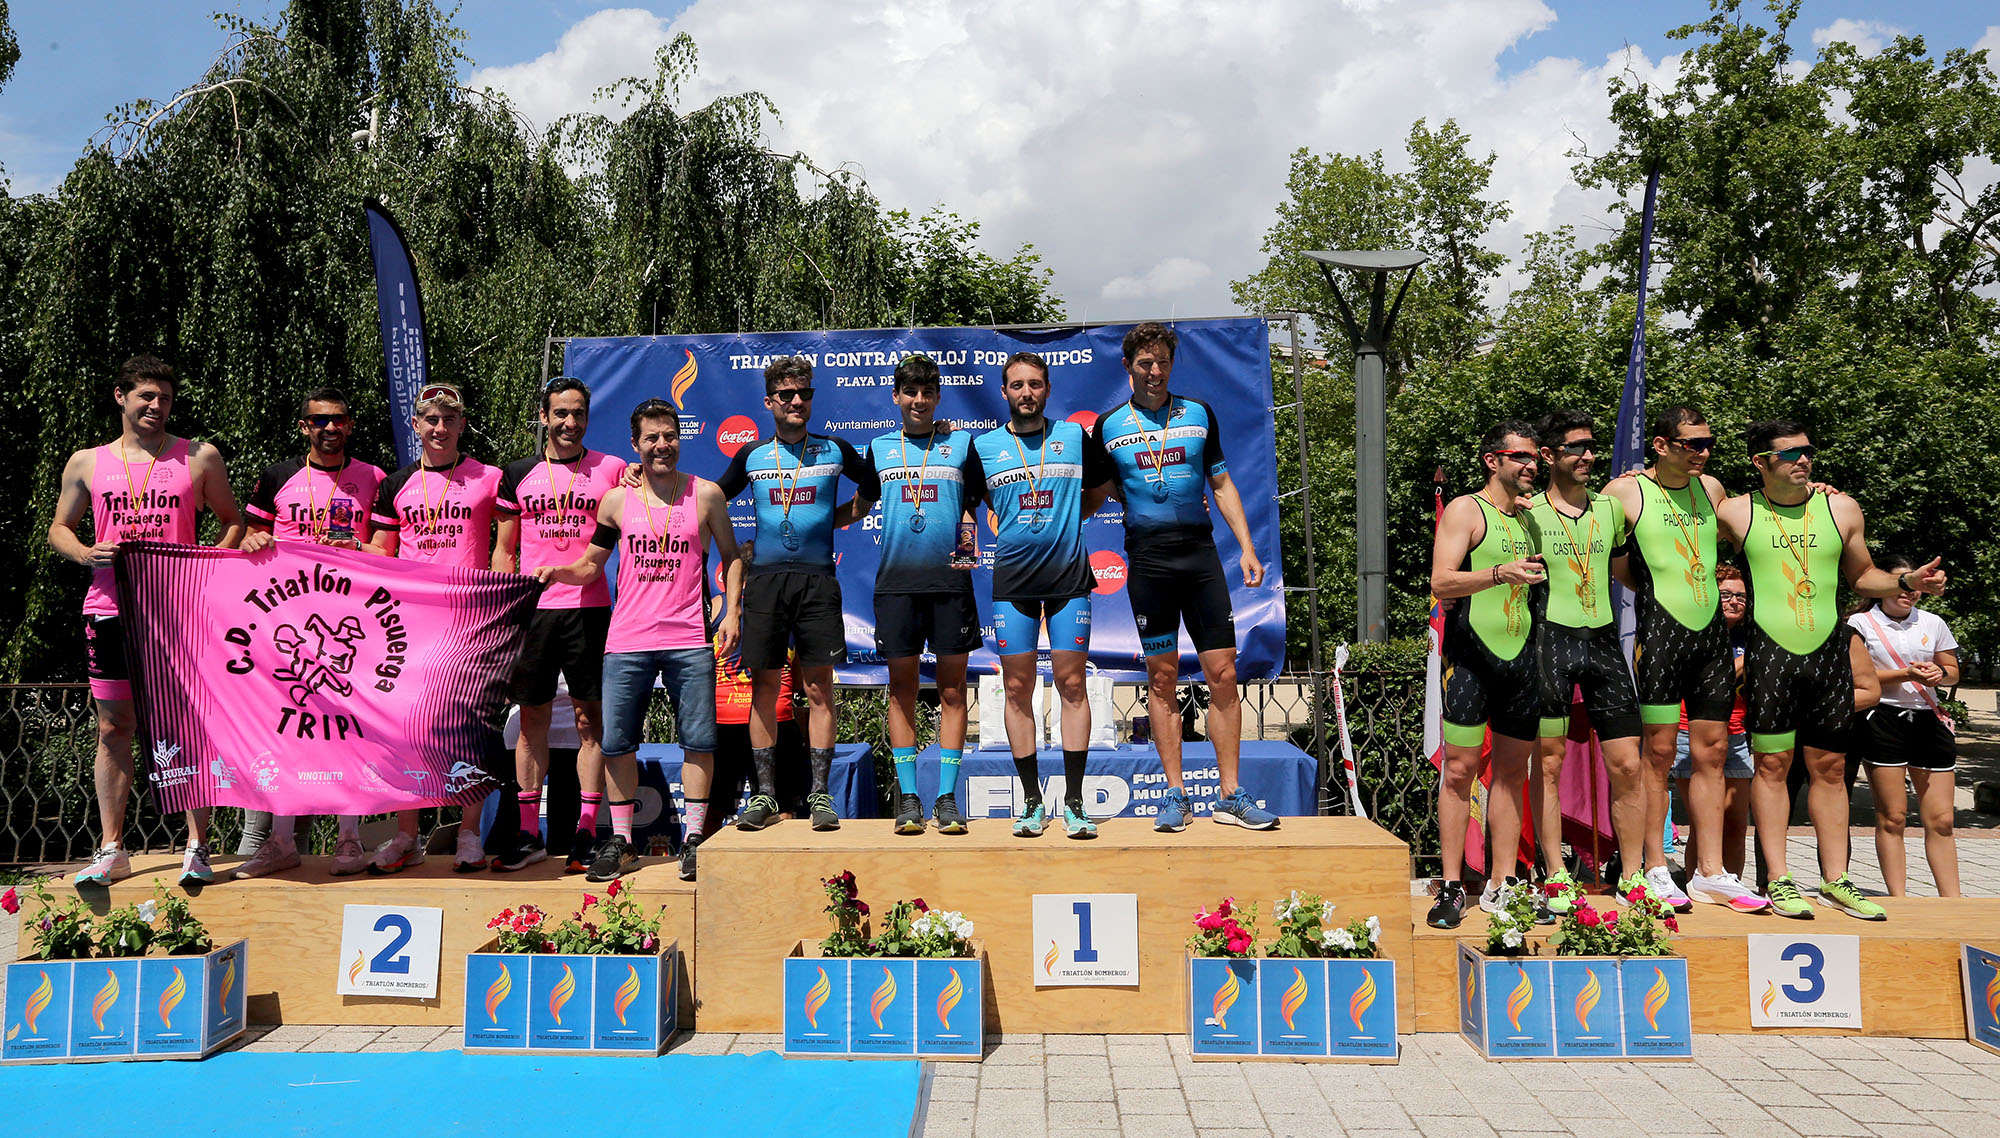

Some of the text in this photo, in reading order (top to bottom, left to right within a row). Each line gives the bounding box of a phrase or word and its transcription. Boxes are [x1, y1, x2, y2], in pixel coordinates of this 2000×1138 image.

[973, 351, 1008, 366] POR
[836, 375, 984, 387] PLAYA DE ORERAS
[824, 418, 998, 433] Ayuntamiento alladolid
[719, 429, 757, 444] Coca-Cola
[1109, 434, 1158, 451] LAGUNA
[750, 472, 792, 481] LAGUNA
[881, 471, 920, 484] LAGUNA
[101, 487, 180, 511] Triatlón
[522, 490, 597, 514] Triatlón
[736, 498, 747, 507] de
[112, 511, 171, 527] Pisuerga
[534, 512, 586, 527] Pisuerga
[539, 529, 581, 539] Valladolid
[1771, 533, 1818, 549] LOPEZ
[634, 554, 682, 571] Pisuerga
[243, 563, 408, 693] Triatlón Pisuerga
[224, 622, 257, 675] C.D.
[276, 706, 365, 741] TRIPI
[162, 764, 201, 779] RURAL
[297, 771, 344, 781] VINOTINTO
[1132, 767, 1220, 785] Funació
[157, 776, 189, 789] ZAMORA
[966, 775, 1130, 819] FMD
[1134, 804, 1159, 817] de
[1073, 902, 1098, 962] 1
[370, 913, 412, 974] 2
[1781, 942, 1825, 1004] 3
[365, 980, 427, 989] TRIATLÓN BOMBEROS
